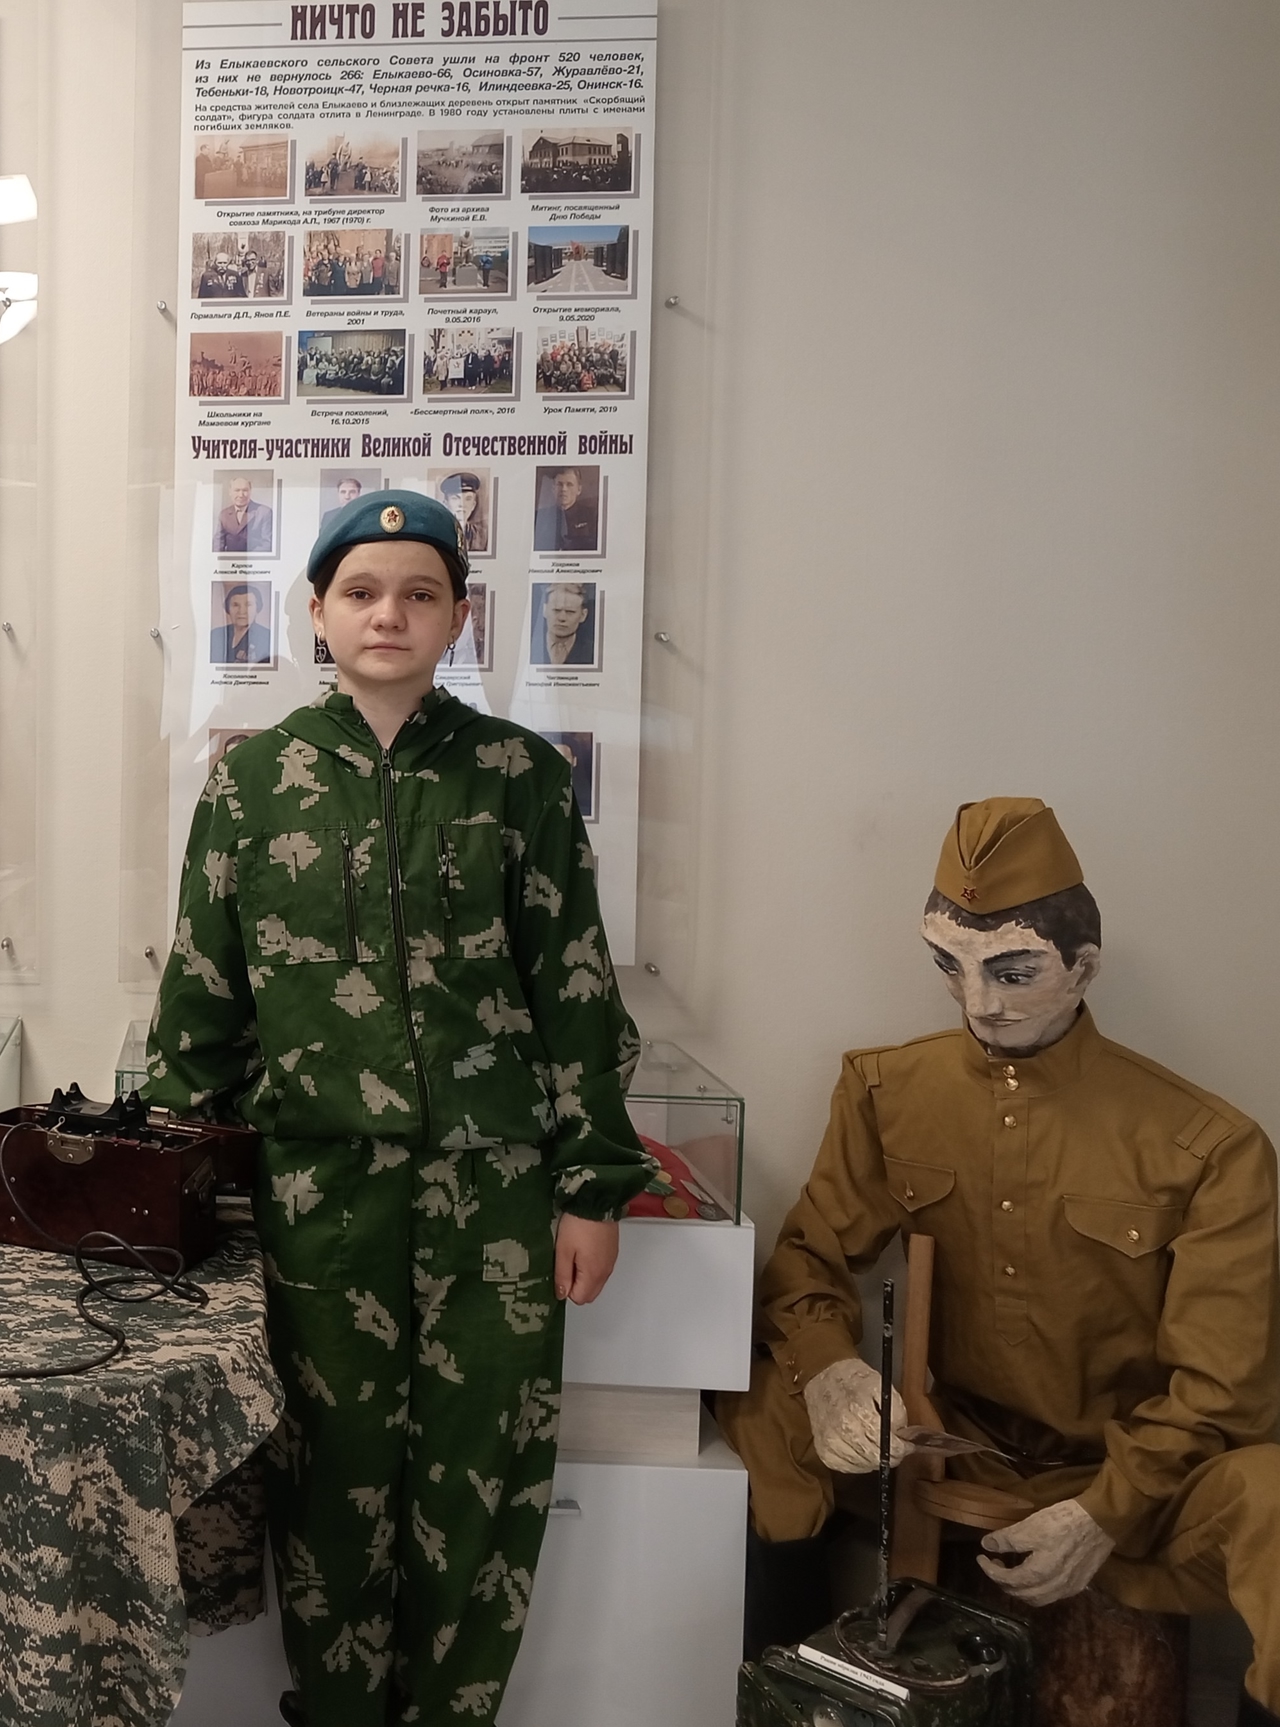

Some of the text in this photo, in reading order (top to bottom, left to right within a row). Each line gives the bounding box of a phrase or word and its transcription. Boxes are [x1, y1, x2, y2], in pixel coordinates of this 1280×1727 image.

[290, 0, 549, 40] НИЧТО НЕ ЗАБЫТО
[195, 59, 210, 69] Из
[219, 59, 308, 68] Елыкаевского
[317, 58, 379, 66] сельского
[389, 55, 433, 65] Совета
[442, 56, 475, 66] ушли
[484, 55, 499, 63] на
[509, 53, 550, 65] фронт
[558, 52, 580, 62] 520
[195, 75, 208, 83] из
[246, 74, 261, 82] не
[269, 73, 331, 83] вернулось
[339, 70, 364, 80] 266:
[369, 83, 412, 95] Черная
[209, 104, 251, 112] средства
[254, 102, 294, 110] жителей
[322, 101, 368, 109] Елыкаево
[191, 430, 633, 459] Учителя-участники Великой Отечественной войны
